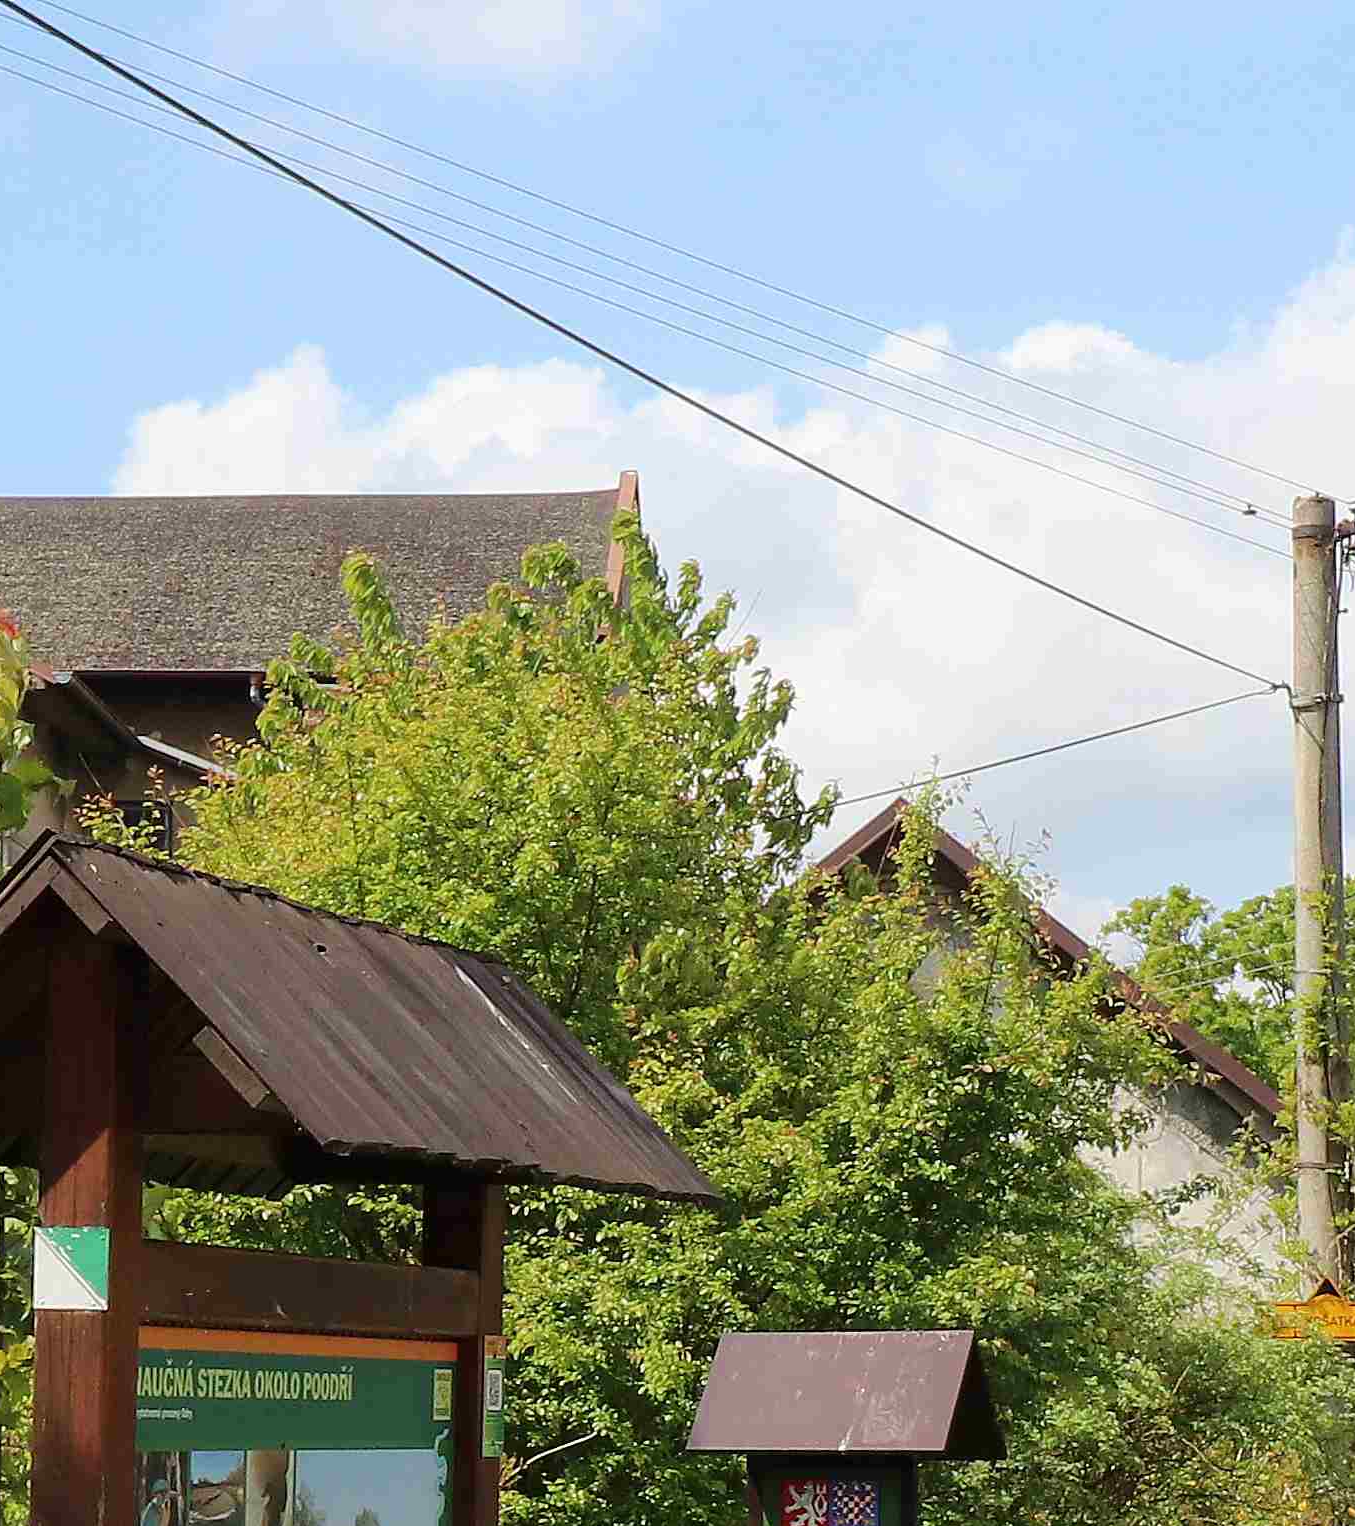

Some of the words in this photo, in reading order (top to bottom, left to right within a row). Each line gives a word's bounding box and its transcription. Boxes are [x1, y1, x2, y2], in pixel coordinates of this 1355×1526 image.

[196, 1368, 251, 1399] STEZKA
[254, 1369, 301, 1399] OKOLO
[303, 1366, 354, 1401] POODŘÍ
